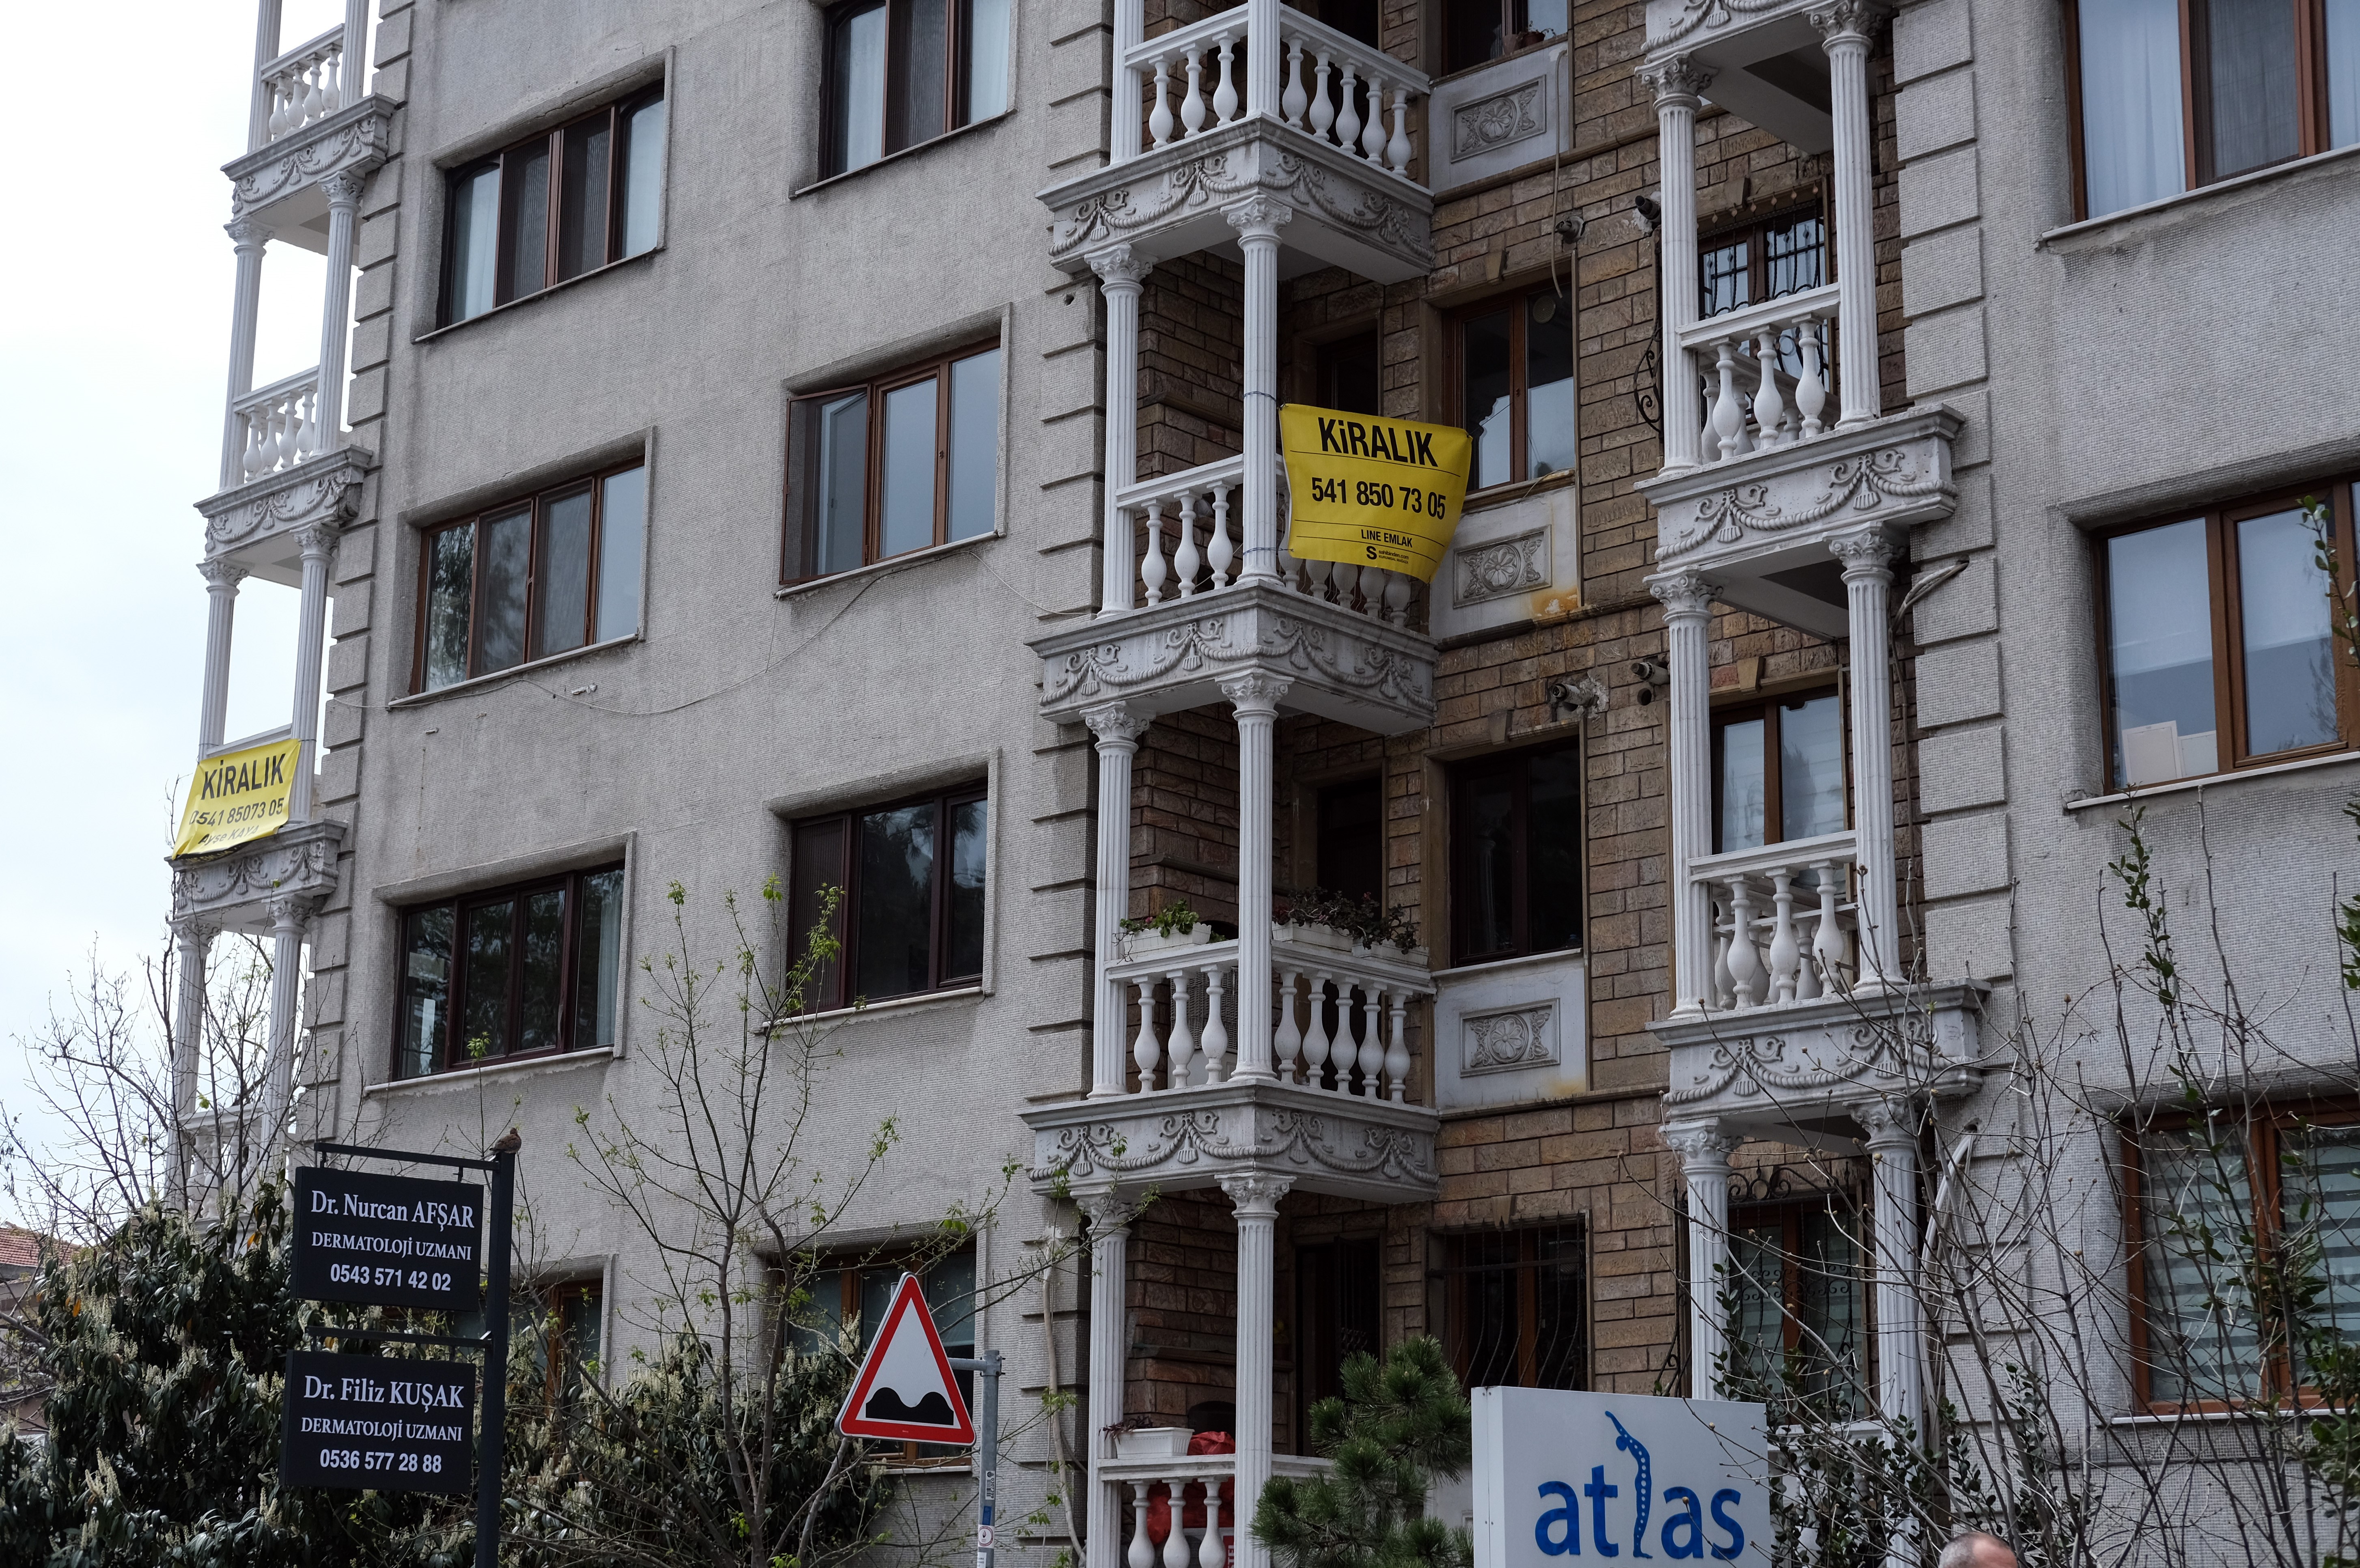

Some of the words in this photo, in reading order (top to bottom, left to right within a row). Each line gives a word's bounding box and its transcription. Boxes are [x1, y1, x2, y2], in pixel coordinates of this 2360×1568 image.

[1312, 477, 1347, 504] 541
[1356, 481, 1394, 508] 850
[1399, 486, 1422, 513] 73
[1427, 491, 1446, 520] 05
[1361, 529, 1382, 541] LINE
[1384, 532, 1413, 548] EMLAK
[1379, 550, 1409, 560] sahibinden.com
[200, 753, 286, 800] KİRALIK
[189, 810, 224, 827] 0541
[226, 801, 266, 824] 85073
[268, 797, 284, 816] 05
[198, 833, 227, 846] Ayşe
[228, 825, 259, 841] KAYA
[311, 1190, 338, 1215] Dr.
[343, 1193, 408, 1221] Nurcan
[411, 1201, 474, 1232] AFŞAR
[312, 1232, 413, 1258] DERMATOLOJİ
[416, 1241, 472, 1260] UZMANI
[330, 1264, 370, 1284] 0543
[375, 1268, 402, 1287] 571
[408, 1271, 427, 1289] 42
[432, 1273, 451, 1291] 02
[304, 1375, 335, 1400] Dr.
[340, 1378, 384, 1403] Filiz
[389, 1381, 464, 1413] KUŞAK
[301, 1417, 403, 1441] DERMATOLOJİ
[406, 1424, 462, 1441] UZMANI
[320, 1449, 360, 1469] 0536
[364, 1452, 394, 1470] 577
[399, 1453, 418, 1472] 28
[422, 1454, 442, 1473] 88
